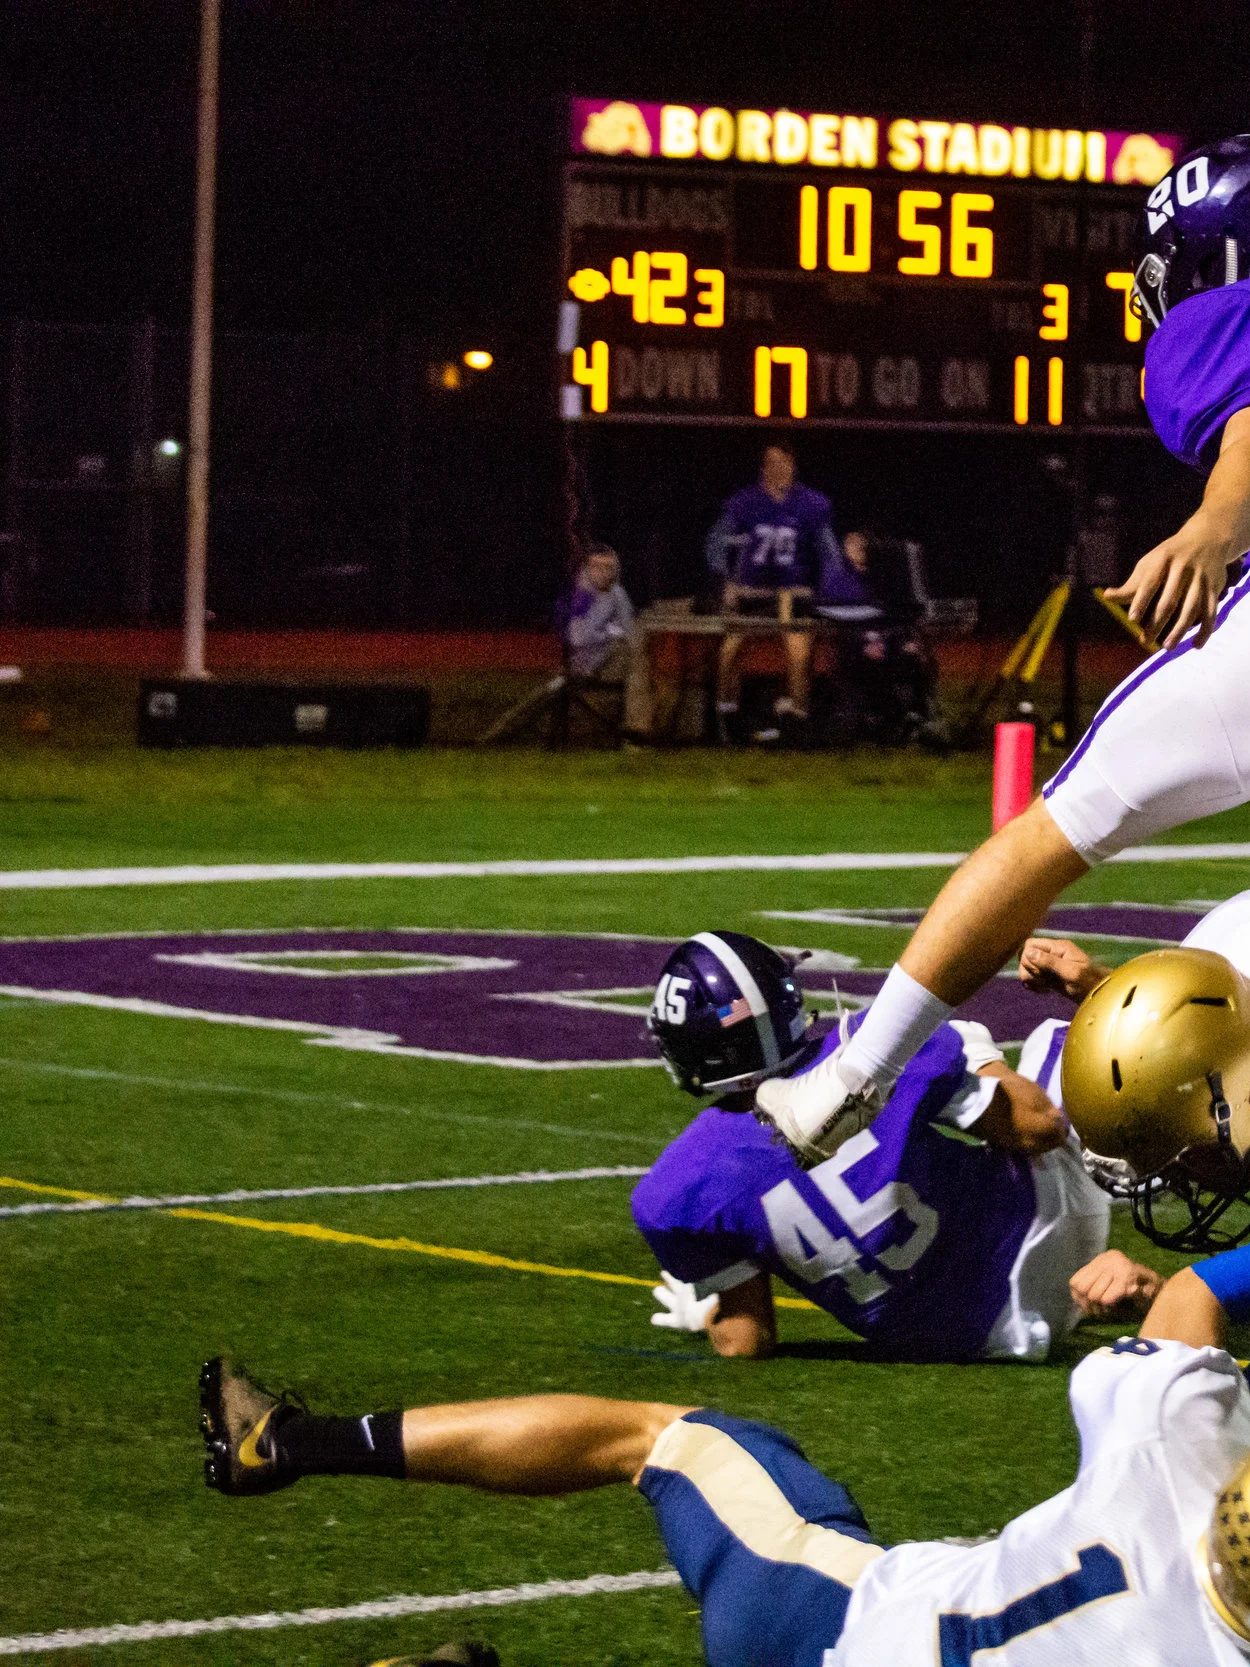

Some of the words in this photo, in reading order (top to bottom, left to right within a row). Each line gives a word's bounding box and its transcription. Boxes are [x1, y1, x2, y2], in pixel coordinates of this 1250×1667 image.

[660, 104, 879, 169] BORDEN
[887, 108, 1107, 183] STADIUM
[1147, 156, 1210, 234] 20
[611, 251, 688, 325] 42
[693, 269, 725, 328] 3
[1038, 283, 1069, 341] 3
[572, 339, 609, 413] 4
[615, 347, 719, 401] DOWN
[754, 345, 808, 418] 17
[1013, 355, 1064, 426] 11
[654, 973, 692, 1025] 45
[760, 1128, 939, 1304] 45
